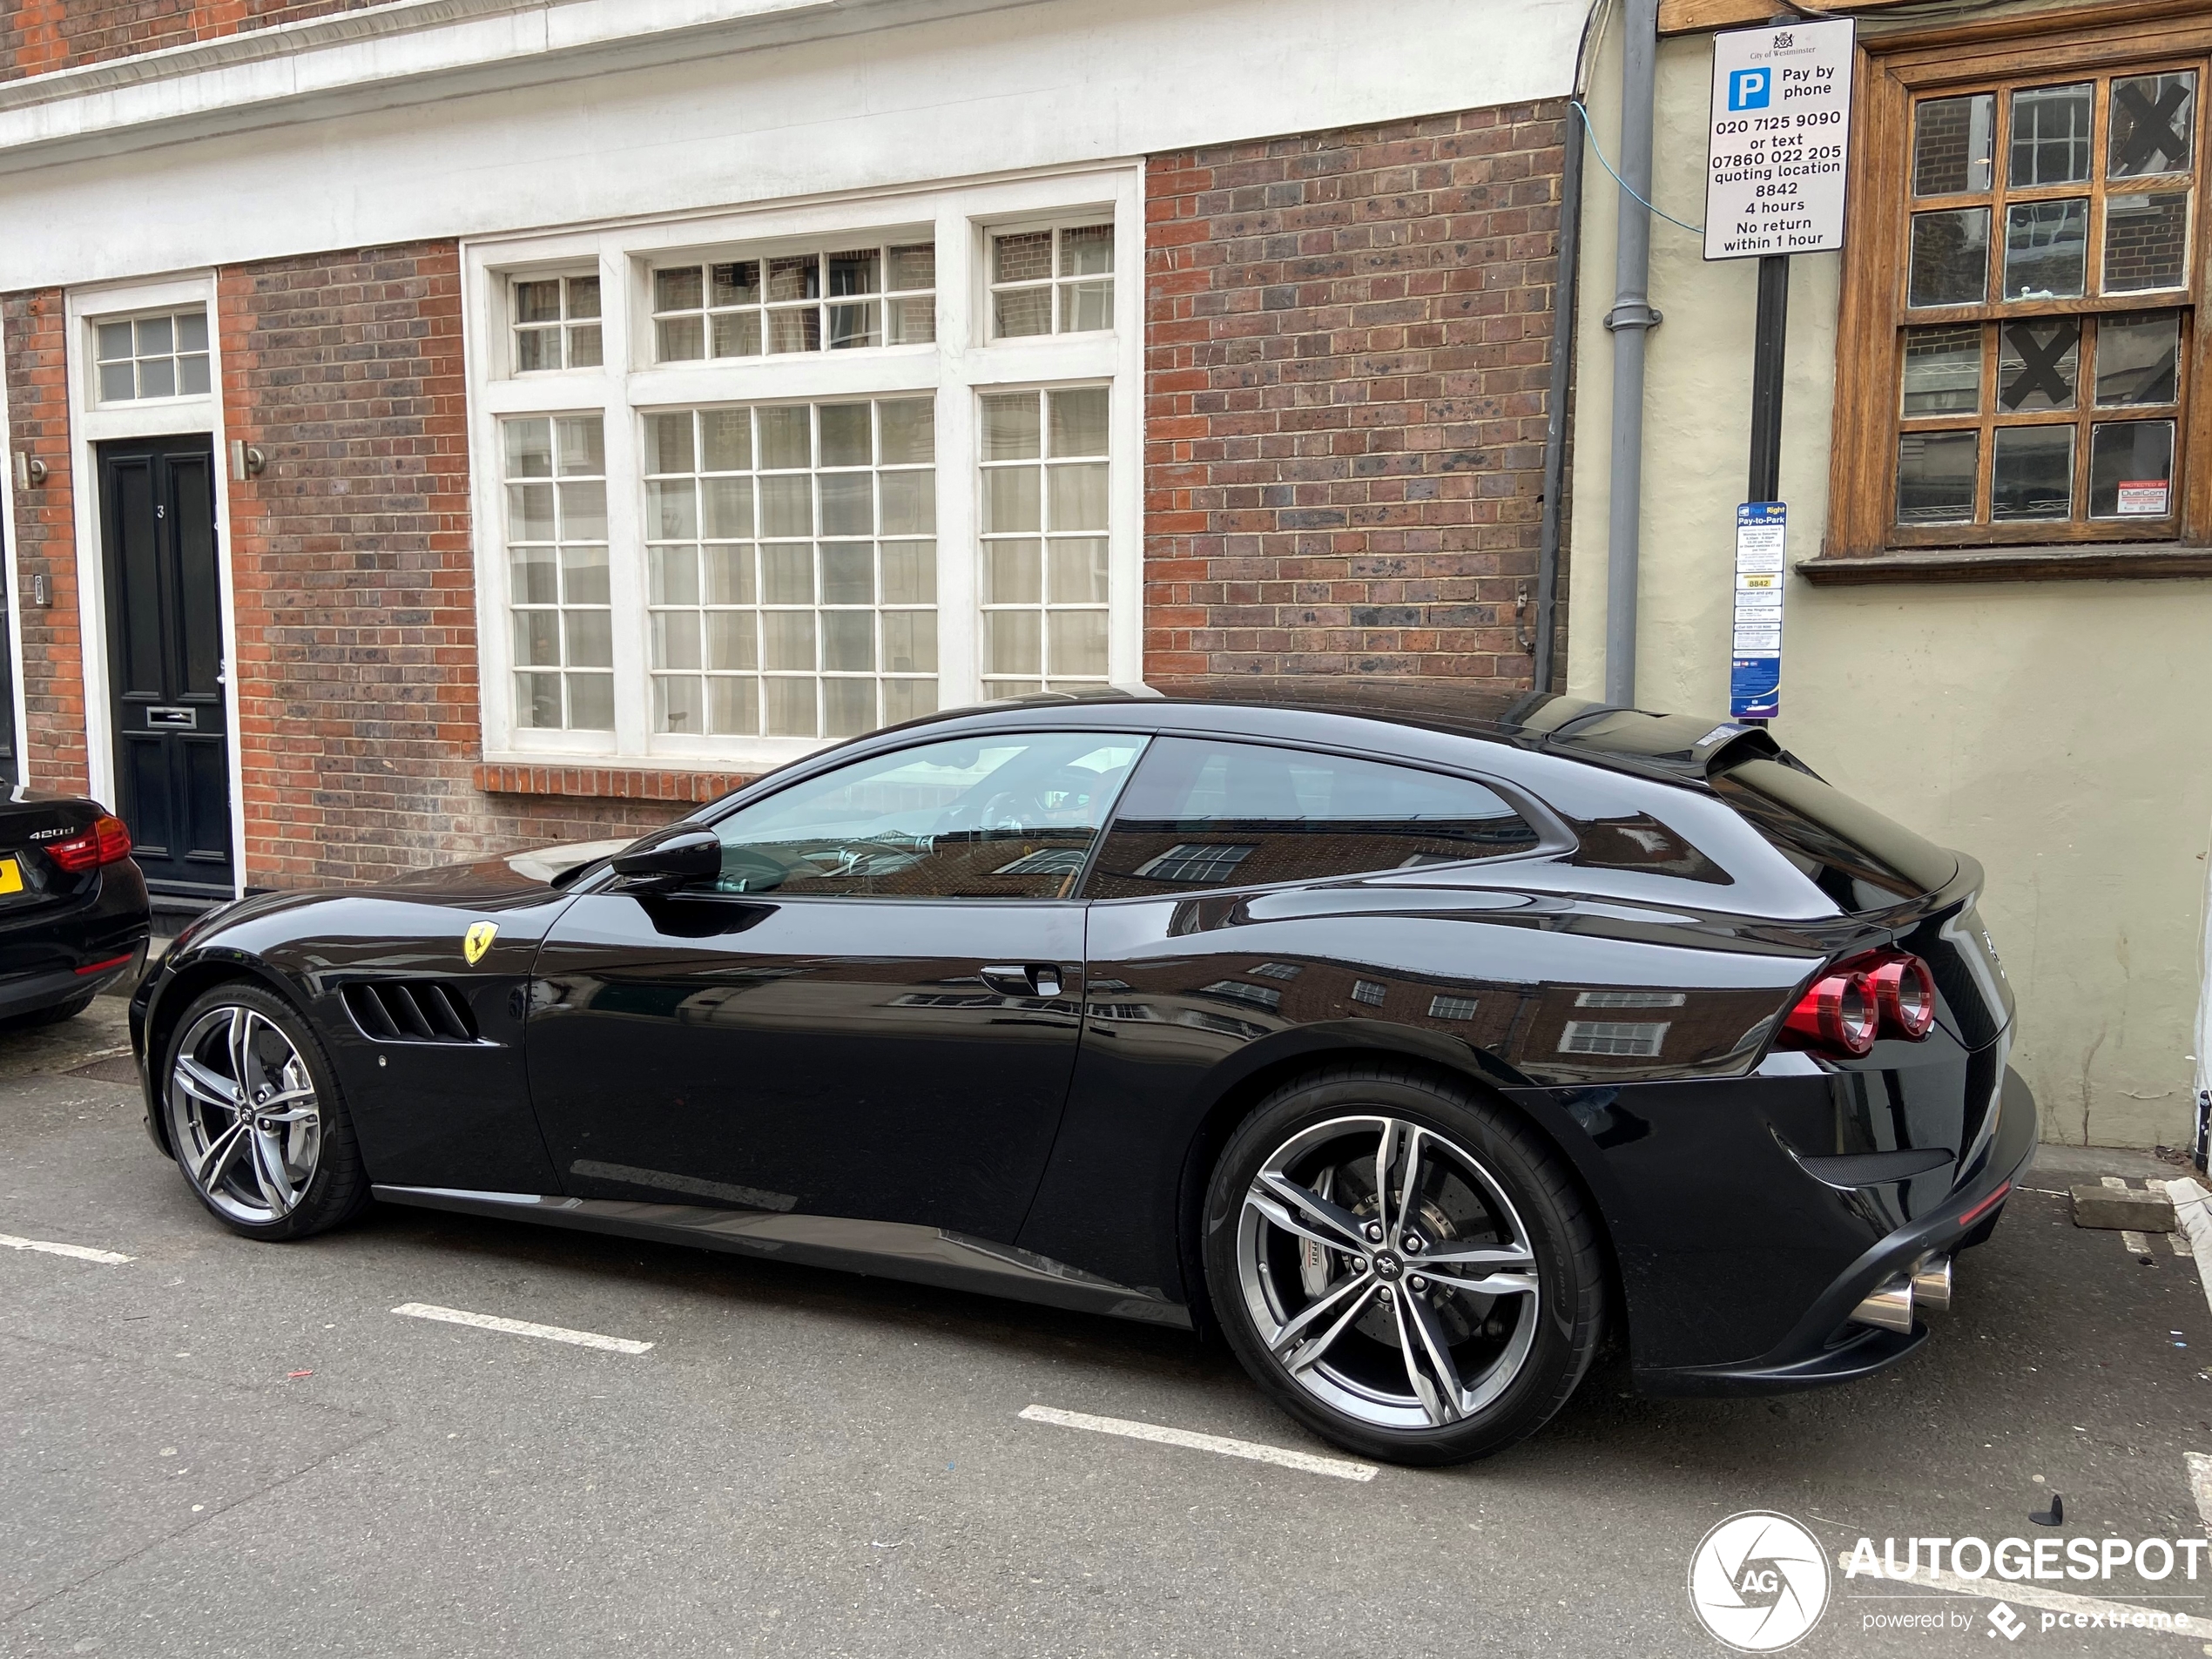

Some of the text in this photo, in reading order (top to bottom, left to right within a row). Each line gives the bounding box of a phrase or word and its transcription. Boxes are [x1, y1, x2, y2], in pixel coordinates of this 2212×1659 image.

[1750, 51, 1763, 60] City
[1774, 46, 1816, 57] Westminster
[1783, 65, 1835, 81] Pay by
[1738, 73, 1764, 106] P
[1784, 84, 1831, 100] phone
[1716, 111, 1841, 135] 020 7125 9090
[1750, 133, 1804, 150] or text
[1712, 145, 1841, 169] 07860 022 205
[1715, 161, 1840, 185] quoting location
[1756, 182, 1797, 198] 8842
[1745, 200, 1804, 214] 4 hours
[1737, 219, 1811, 234] No return
[1723, 234, 1824, 252] within 1 hour
[157, 505, 165, 519] 3
[1738, 516, 1785, 526] Pay-to-Park
[30, 826, 75, 840] 420d
